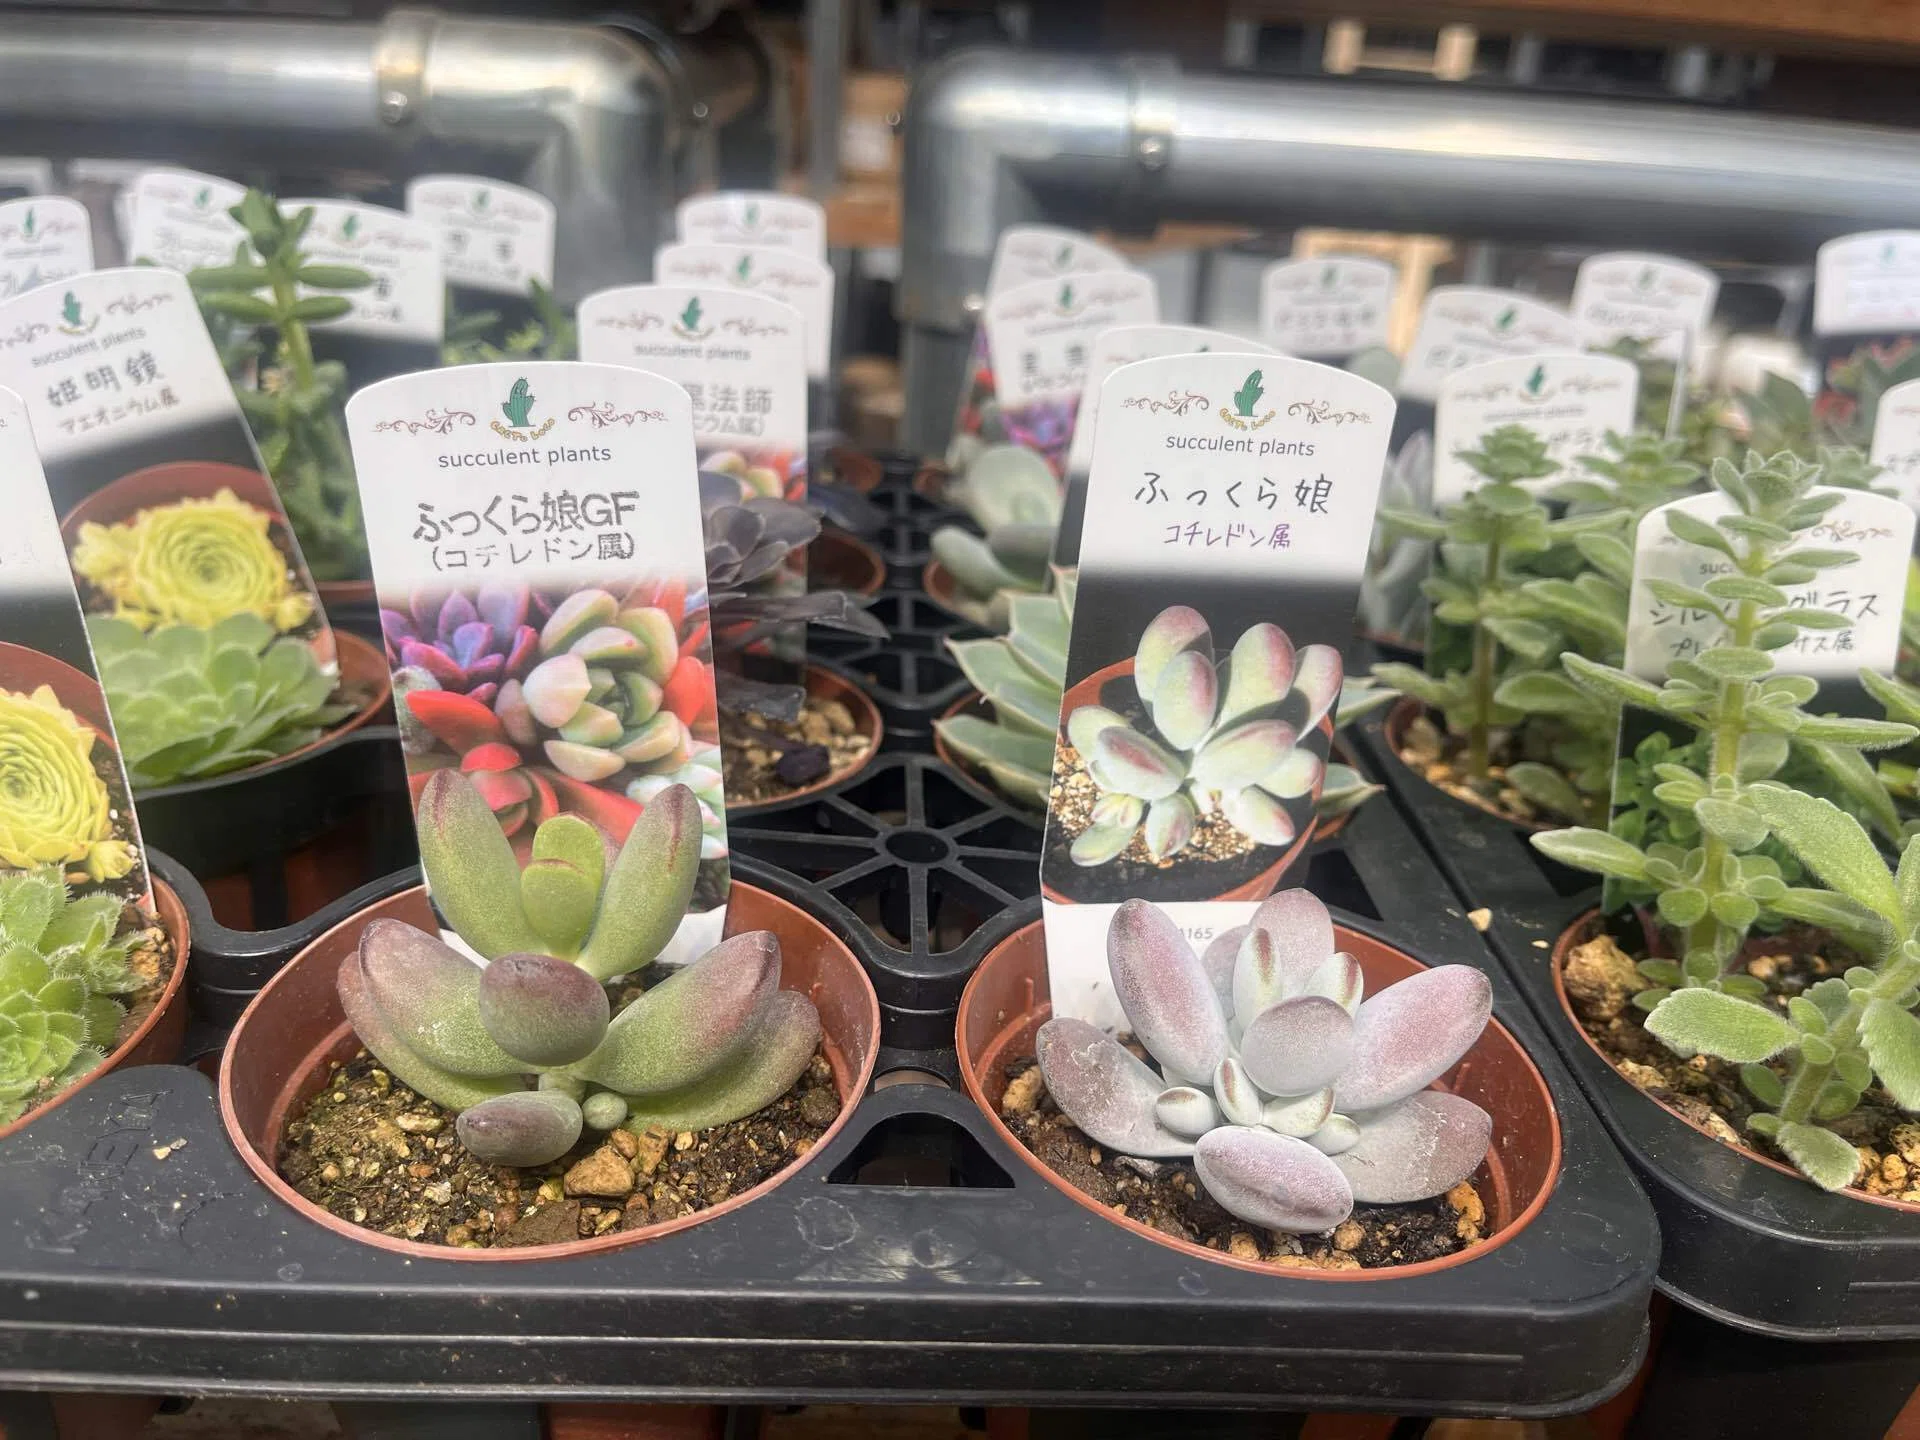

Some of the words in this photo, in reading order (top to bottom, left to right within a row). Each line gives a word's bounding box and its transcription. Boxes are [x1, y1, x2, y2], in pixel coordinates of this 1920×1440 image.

[438, 448, 541, 468] succulent
[548, 446, 612, 466] plants
[1166, 435, 1254, 453] succulent
[1259, 438, 1315, 456] plants
[1134, 471, 1334, 514] ふっくら娘
[1163, 520, 1291, 549] コチレドン属
